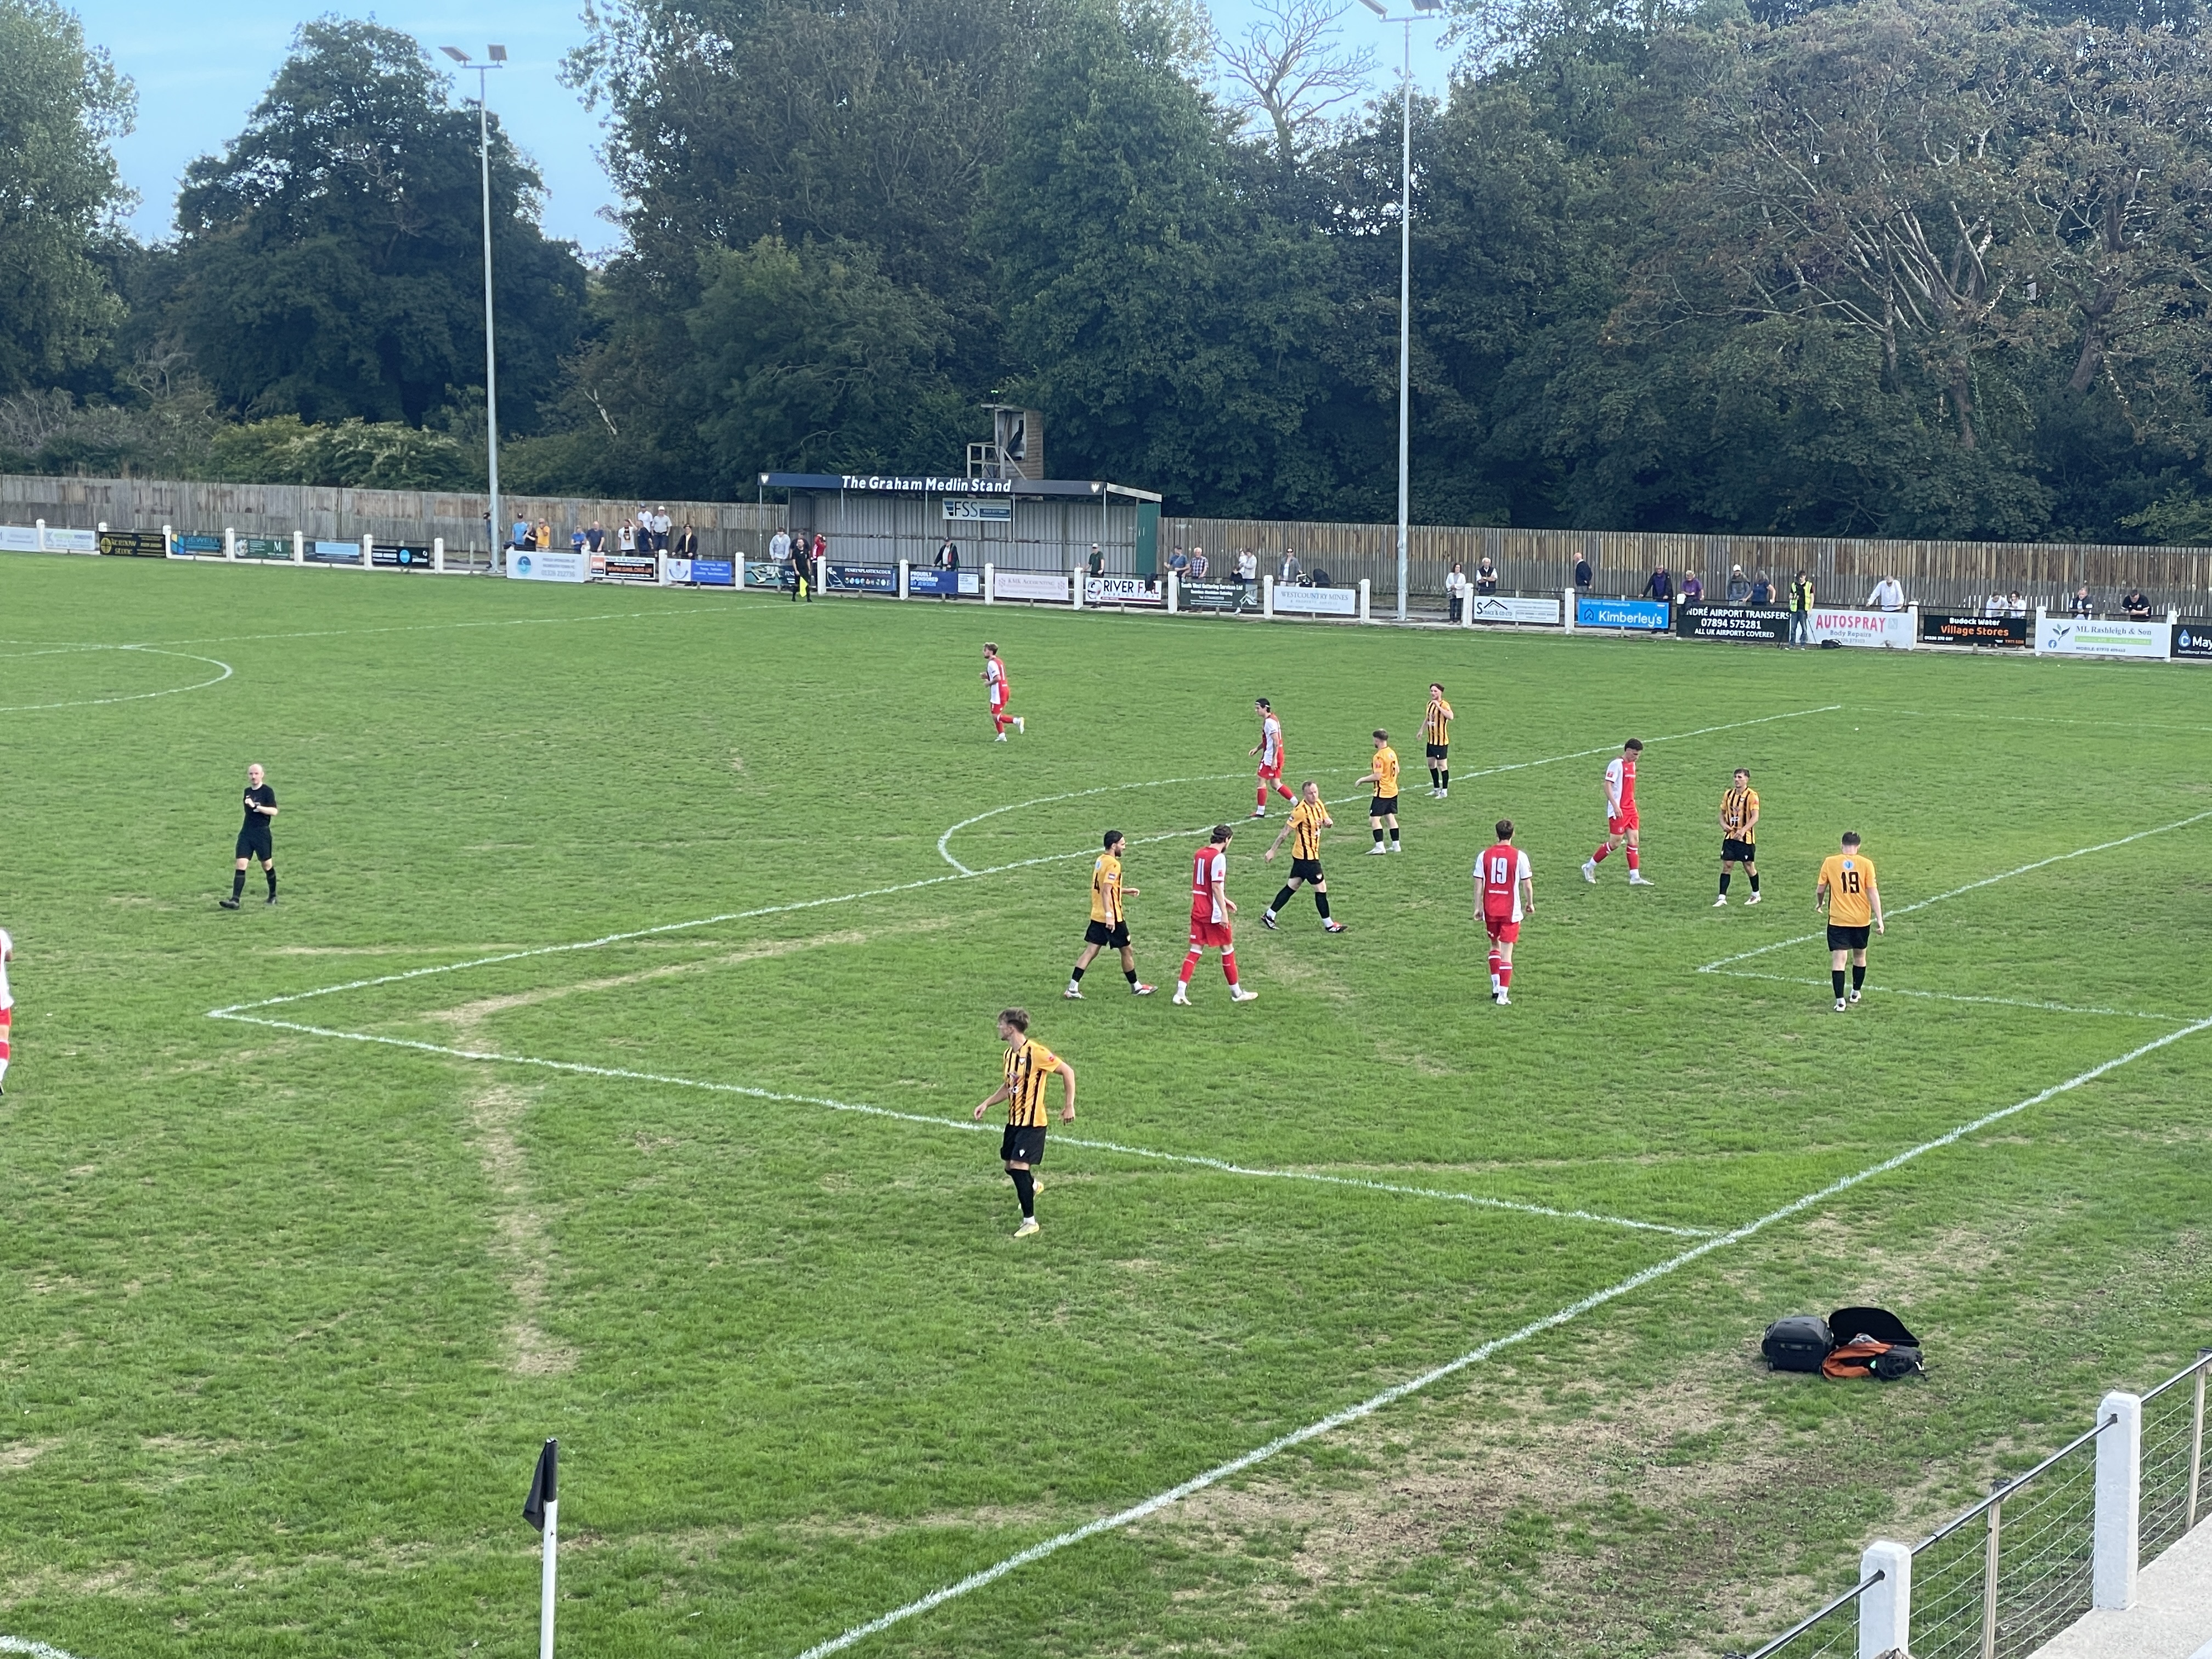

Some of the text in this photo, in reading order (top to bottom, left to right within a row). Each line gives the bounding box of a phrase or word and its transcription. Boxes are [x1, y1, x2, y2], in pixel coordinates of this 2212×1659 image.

[842, 476, 1012, 492] The Graham Medlin Stand
[955, 501, 978, 517] FSS
[273, 541, 282, 552] M
[1104, 580, 1134, 593] RIVER
[1281, 591, 1328, 600] WESTCOUNTRY
[1599, 611, 1662, 628] Kimberley's
[1686, 607, 1790, 620] NDRÉ AIRPORT TRANSFERS
[1701, 618, 1761, 630] 07894 575281
[1816, 614, 1886, 633] AUTOSPRAY
[1949, 617, 1977, 625] Budock
[1940, 625, 2009, 636] Village Stores
[2091, 626, 2126, 636] Rashleigh
[1197, 857, 1205, 885] 11
[1491, 857, 1508, 884] 19
[1094, 872, 1101, 894] 4
[1841, 872, 1860, 894] 19
